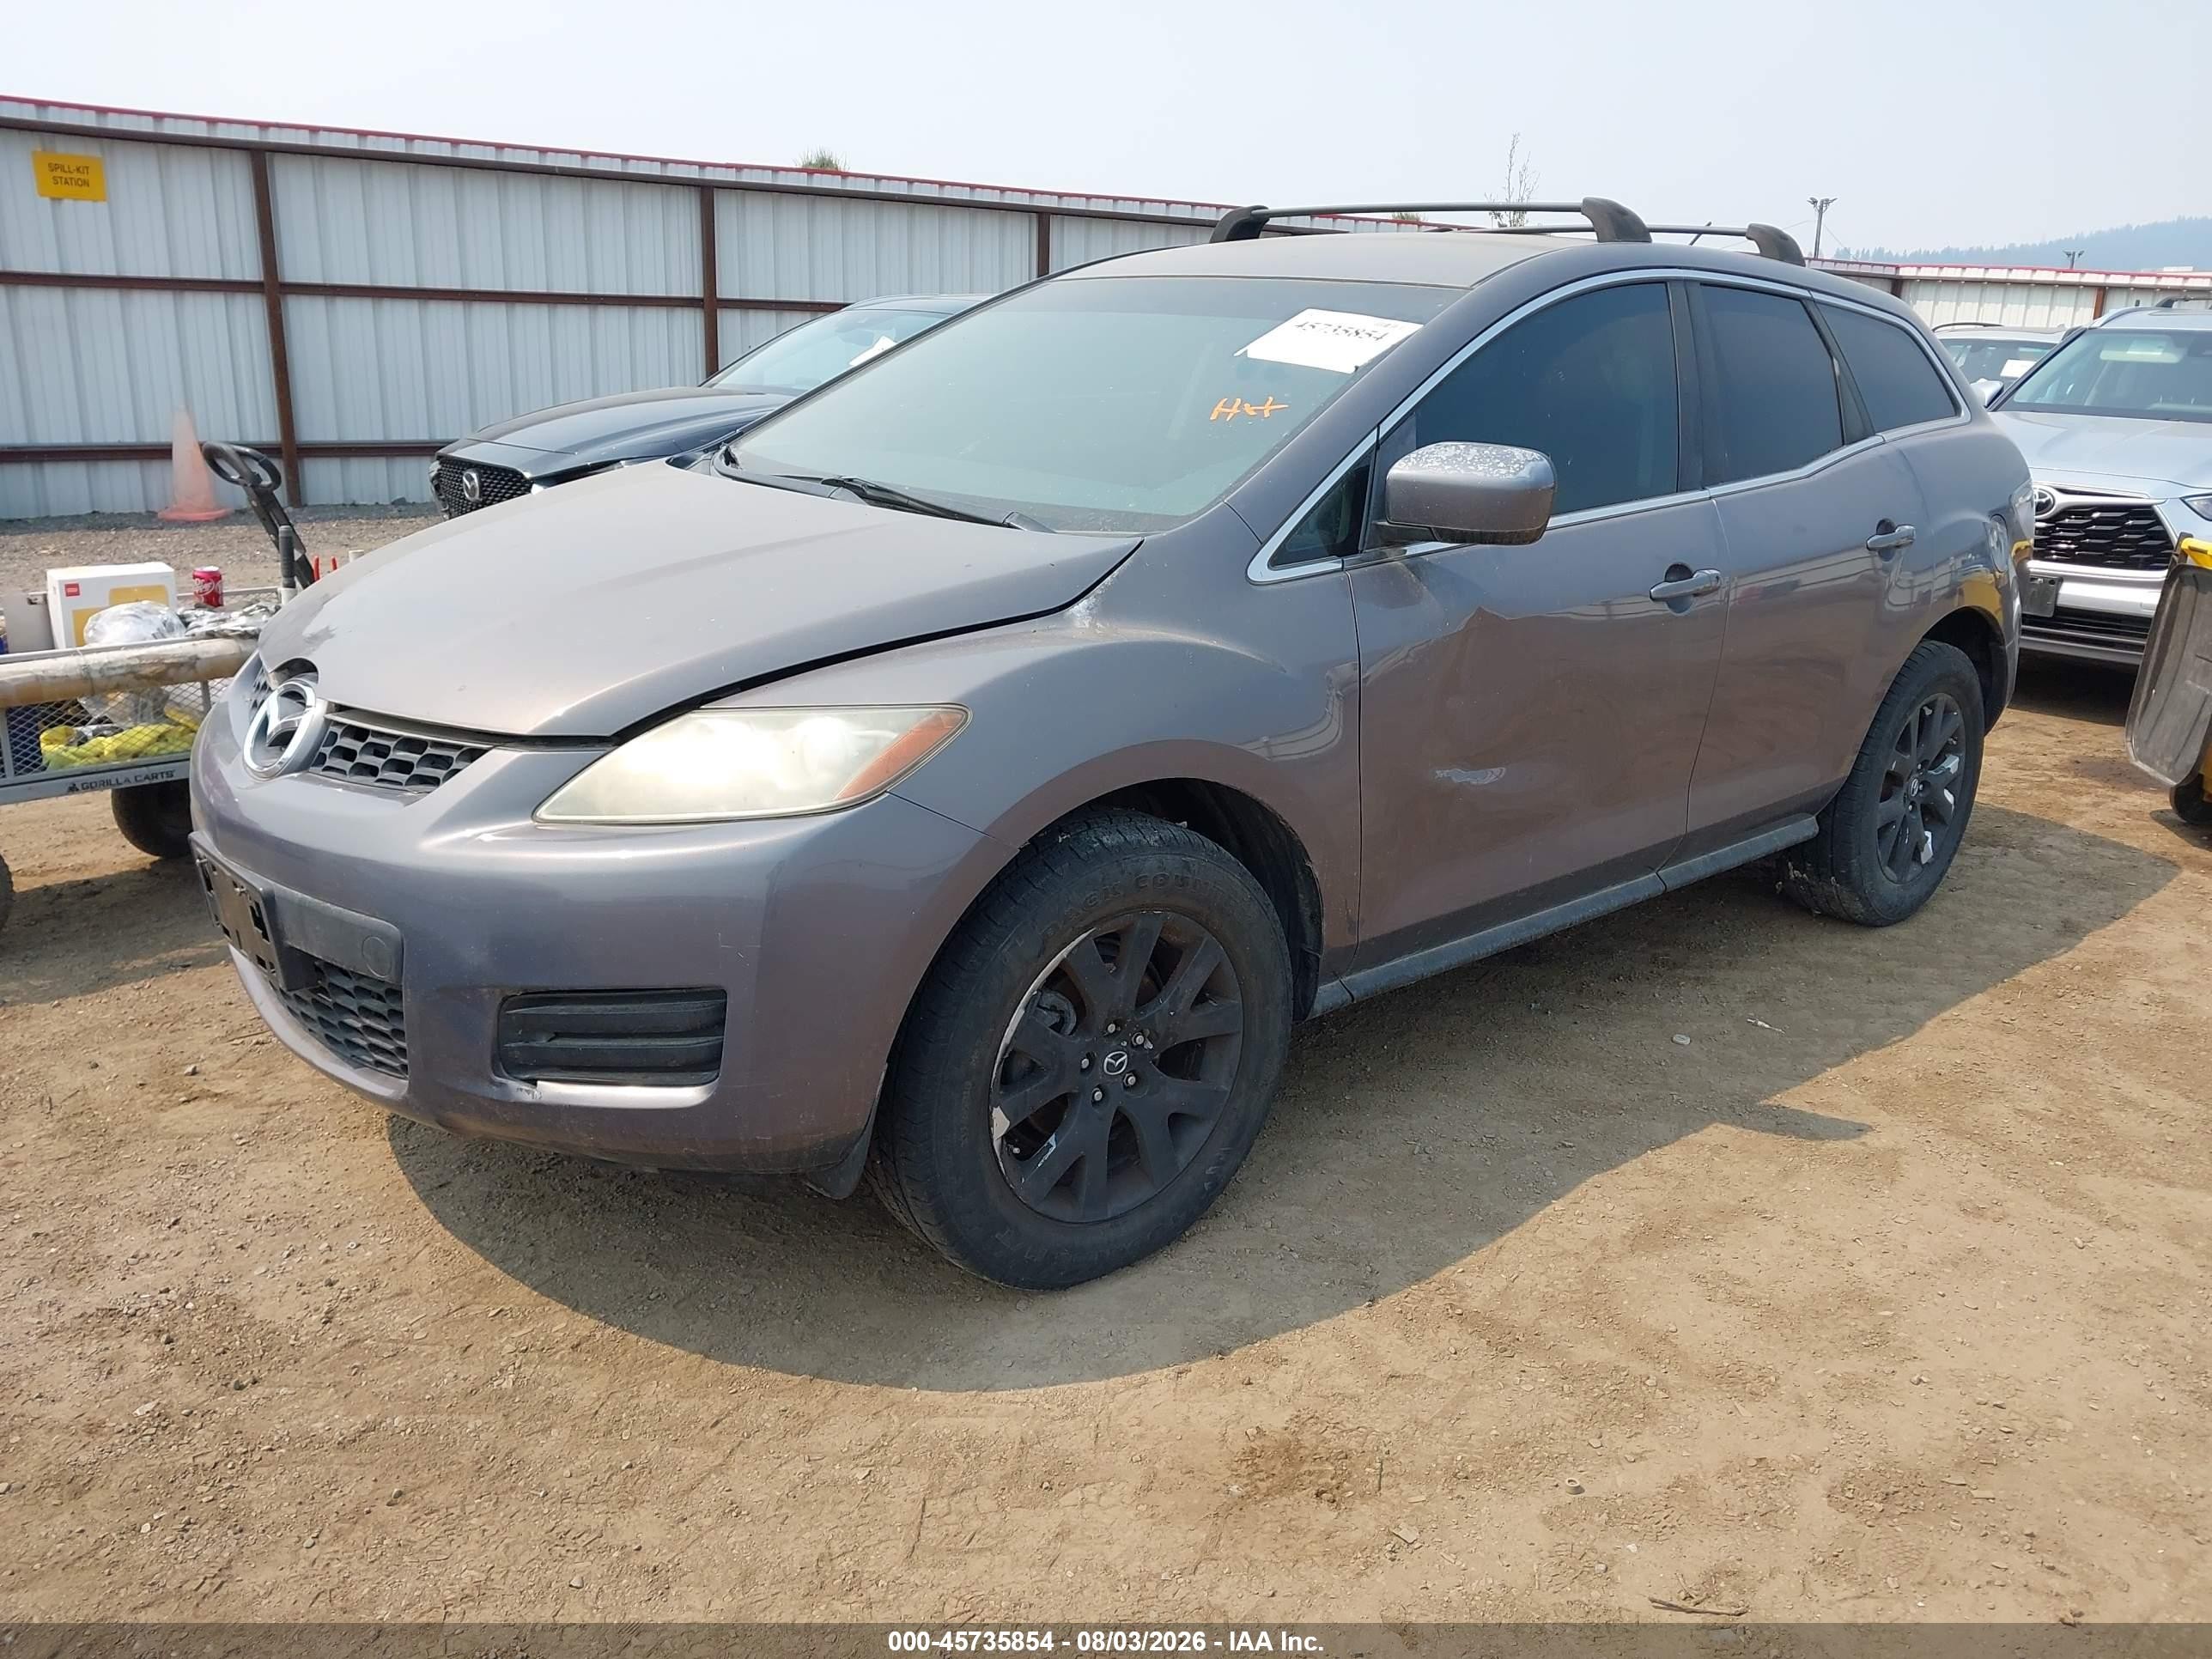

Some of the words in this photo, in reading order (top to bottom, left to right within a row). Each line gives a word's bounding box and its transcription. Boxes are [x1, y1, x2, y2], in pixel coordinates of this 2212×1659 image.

[47, 162, 90, 175] SPILL-KIT
[52, 175, 90, 187] STATION
[81, 776, 132, 791] GORILLA
[134, 769, 175, 782] CARTS
